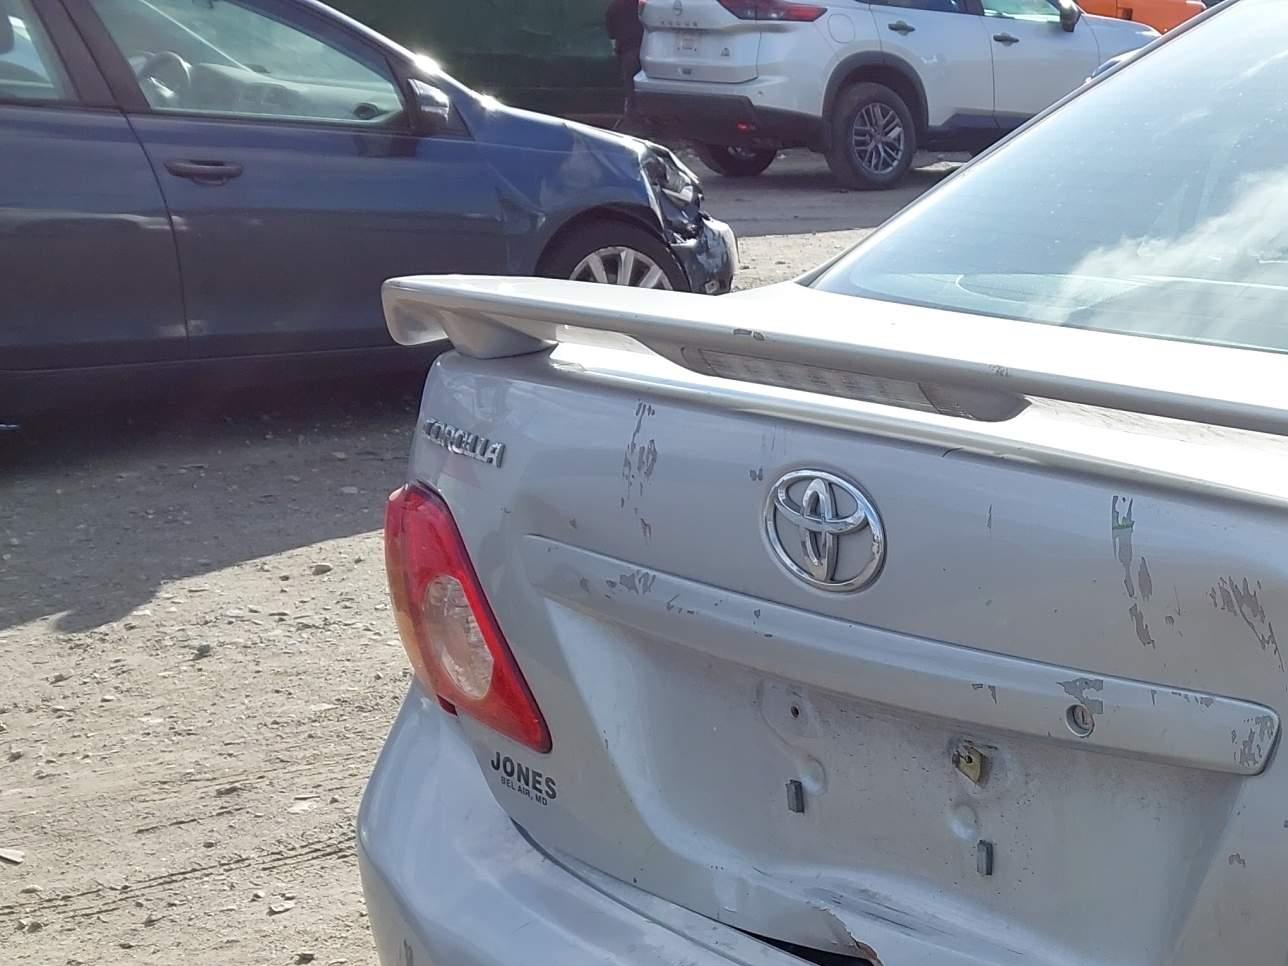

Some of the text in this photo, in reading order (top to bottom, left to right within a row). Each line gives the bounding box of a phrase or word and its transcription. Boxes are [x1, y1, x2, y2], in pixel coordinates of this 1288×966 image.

[491, 751, 557, 800] JONES
[500, 775, 516, 791] BEL
[535, 793, 548, 807] MD
